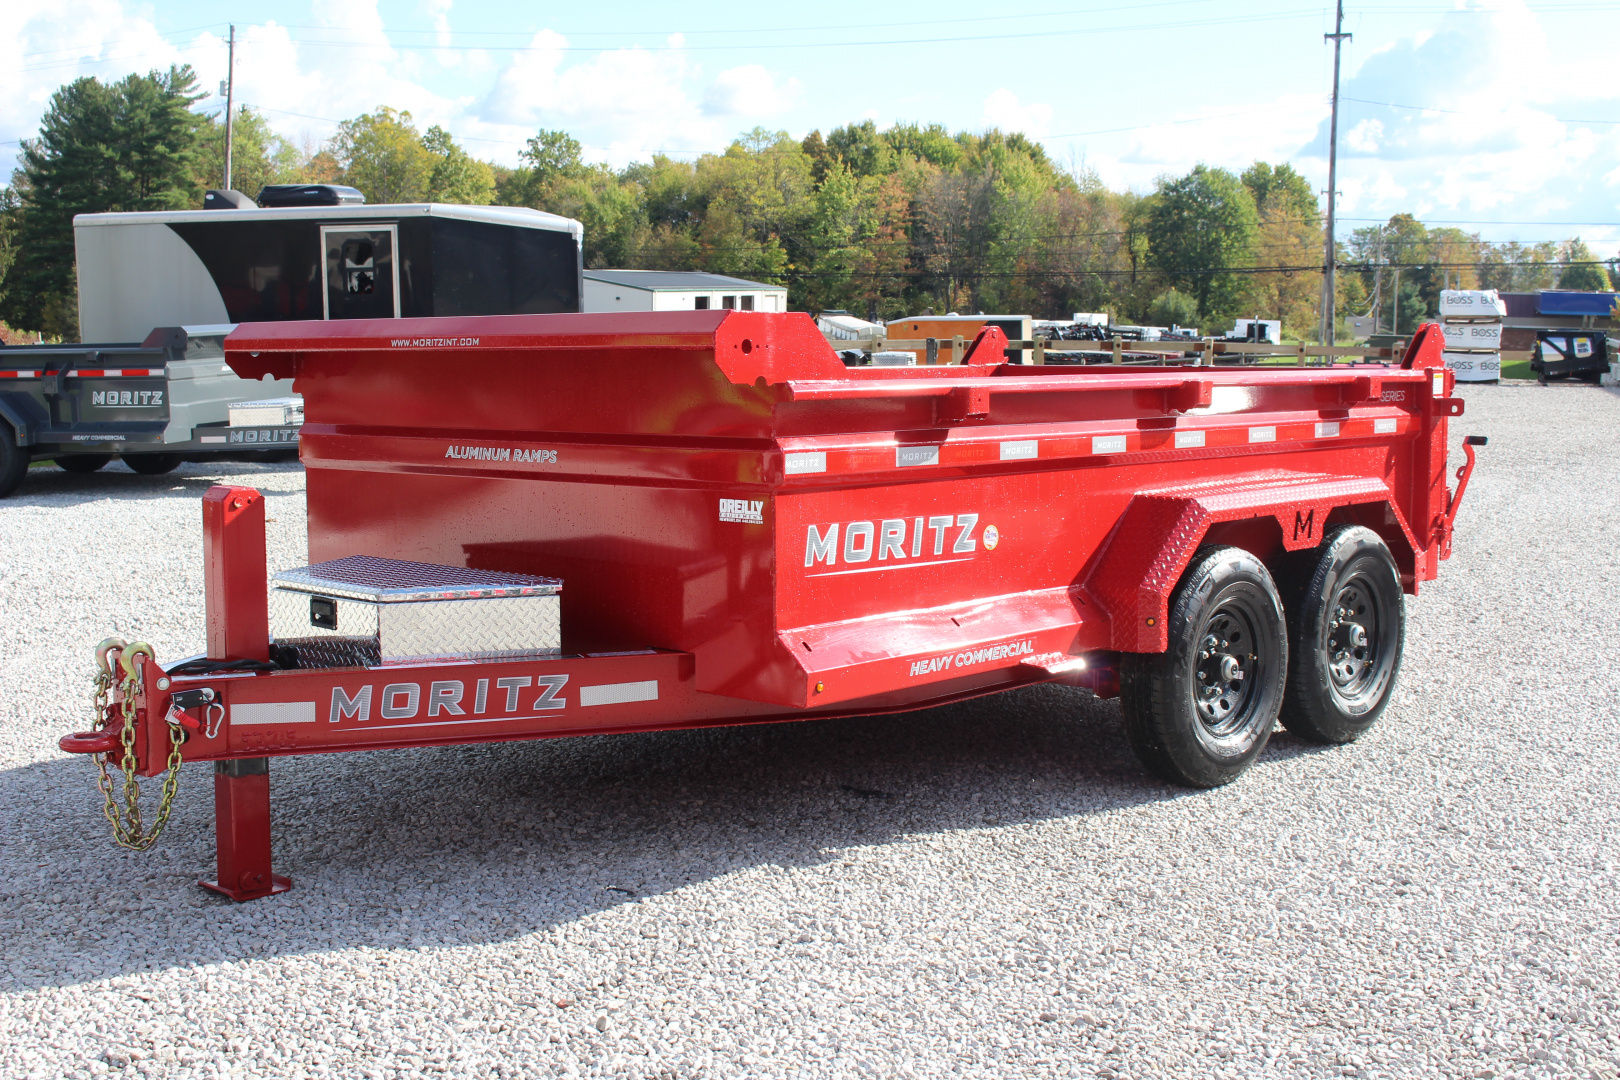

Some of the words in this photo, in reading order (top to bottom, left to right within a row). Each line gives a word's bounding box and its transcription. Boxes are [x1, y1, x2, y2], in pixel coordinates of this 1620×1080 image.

[1447, 296, 1473, 304] BOSS
[1471, 328, 1498, 337] BOSS
[391, 337, 480, 347] WWW.MORITZINT.COM
[1447, 361, 1473, 370] BOSS
[92, 391, 163, 405] MORITZ
[1380, 390, 1406, 402] SERIES
[1318, 426, 1337, 434] MORITZ
[1377, 422, 1394, 430] MORITZ
[230, 429, 299, 443] MORITZ
[1178, 436, 1201, 444] MORITZ
[1252, 431, 1272, 439] MORITZ
[1097, 441, 1122, 449] MORITZ
[445, 445, 511, 462] ALUMINUM
[513, 448, 558, 464] RAMPS
[1005, 446, 1033, 455] MORITZ
[902, 451, 933, 461] MORITZ
[785, 458, 819, 468] MORITZ
[1293, 508, 1314, 541] M
[804, 513, 979, 567] MORITZ
[910, 655, 953, 676] HEAVY
[955, 641, 1034, 667] COMMERCIAL
[328, 673, 570, 723] MORITZ
